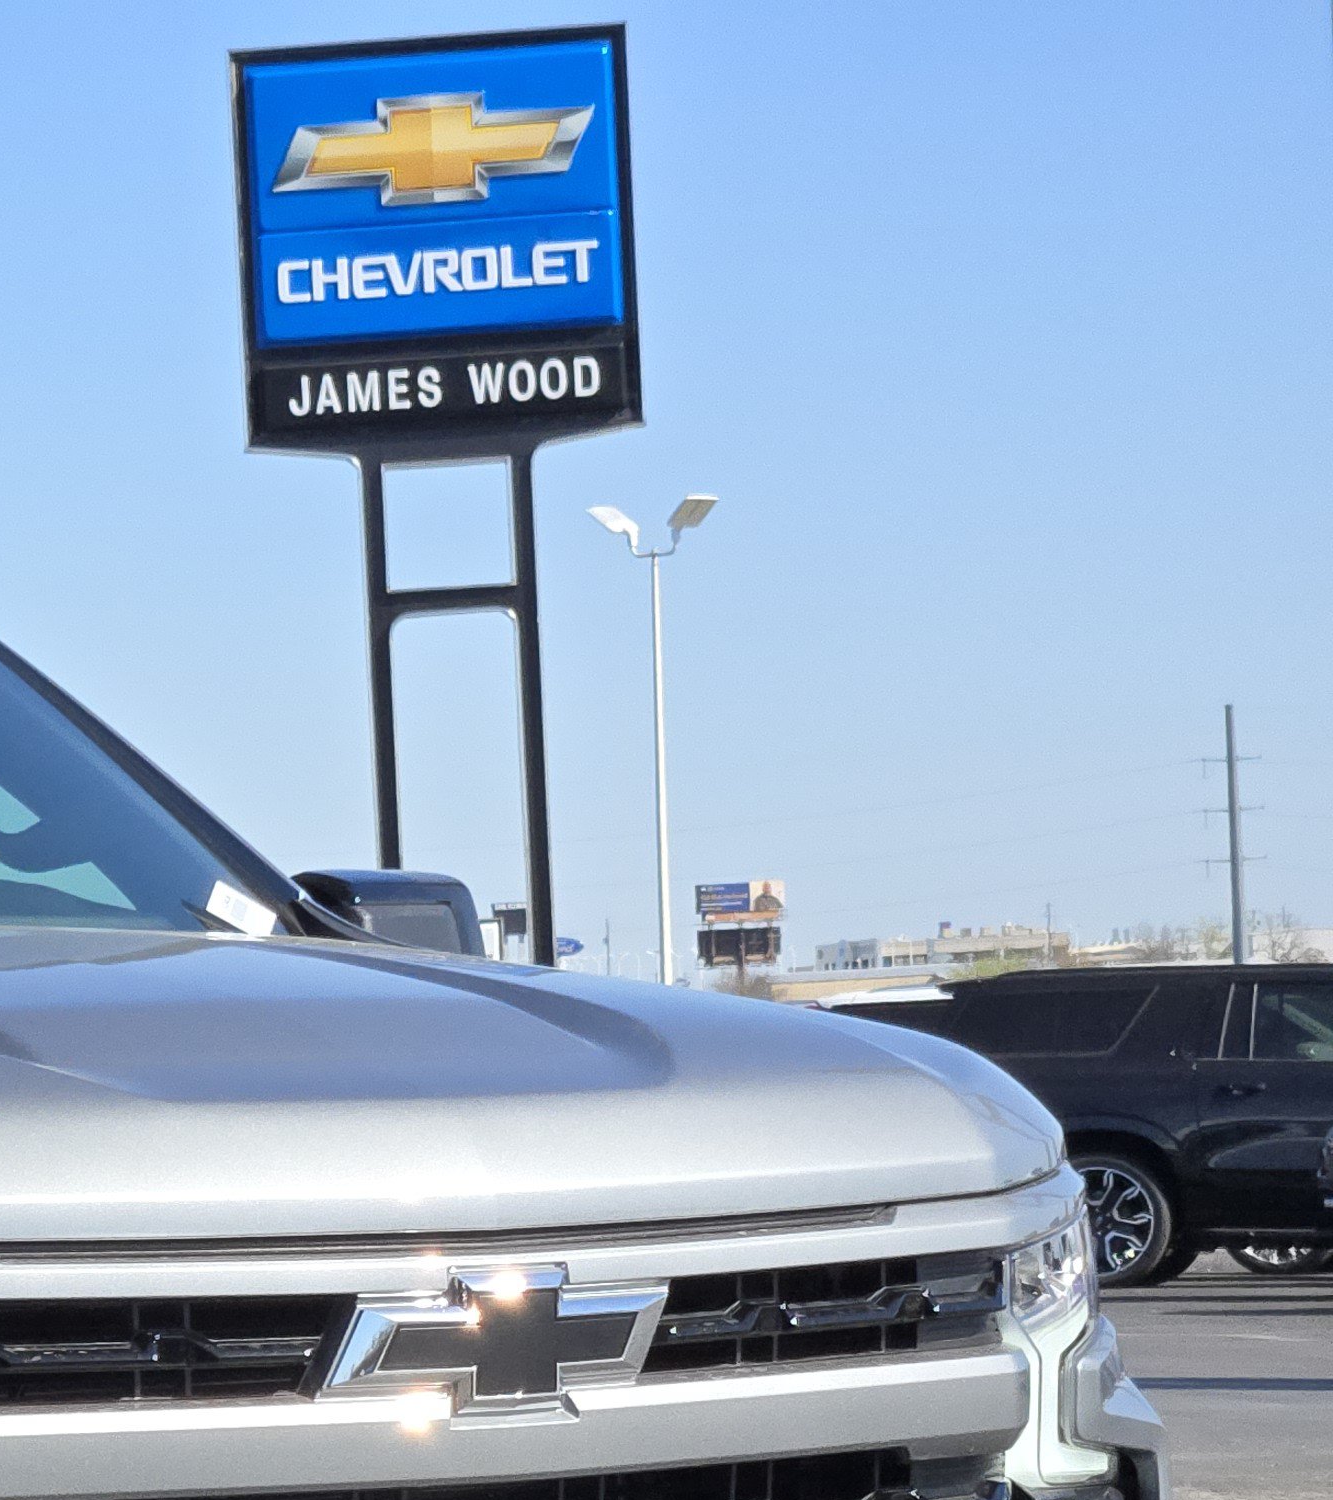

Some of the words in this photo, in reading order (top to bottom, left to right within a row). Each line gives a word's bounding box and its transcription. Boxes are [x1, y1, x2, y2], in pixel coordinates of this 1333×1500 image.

[276, 239, 599, 304] CHEVROLET
[288, 366, 442, 418] JAMES
[467, 356, 601, 405] WOOD
